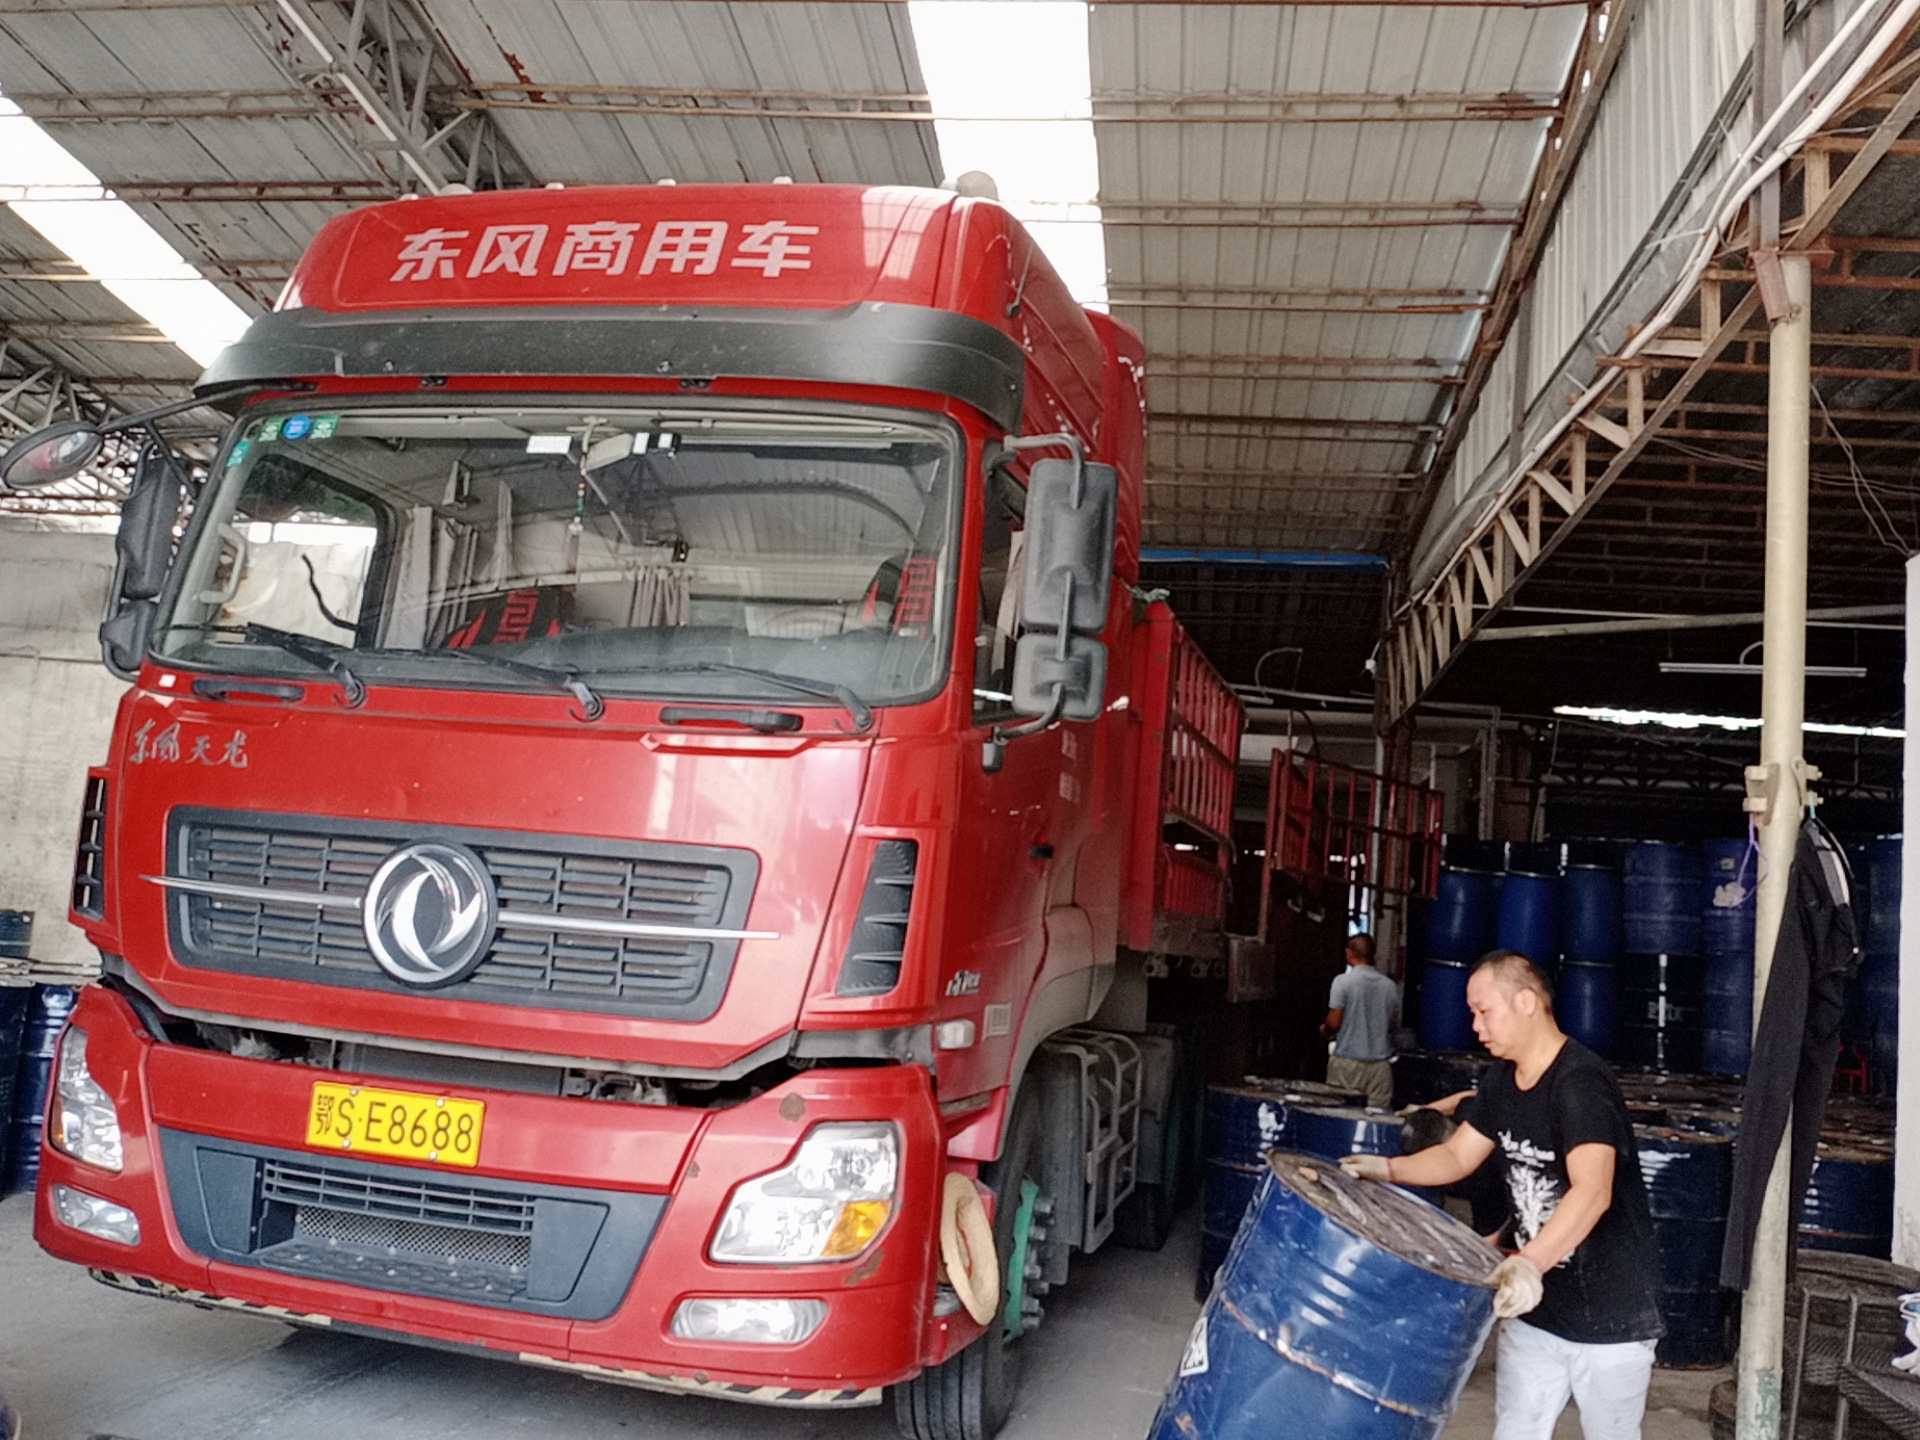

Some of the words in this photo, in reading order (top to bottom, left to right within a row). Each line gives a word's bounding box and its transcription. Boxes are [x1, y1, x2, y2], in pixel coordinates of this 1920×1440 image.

[389, 220, 820, 282] 东风商用车
